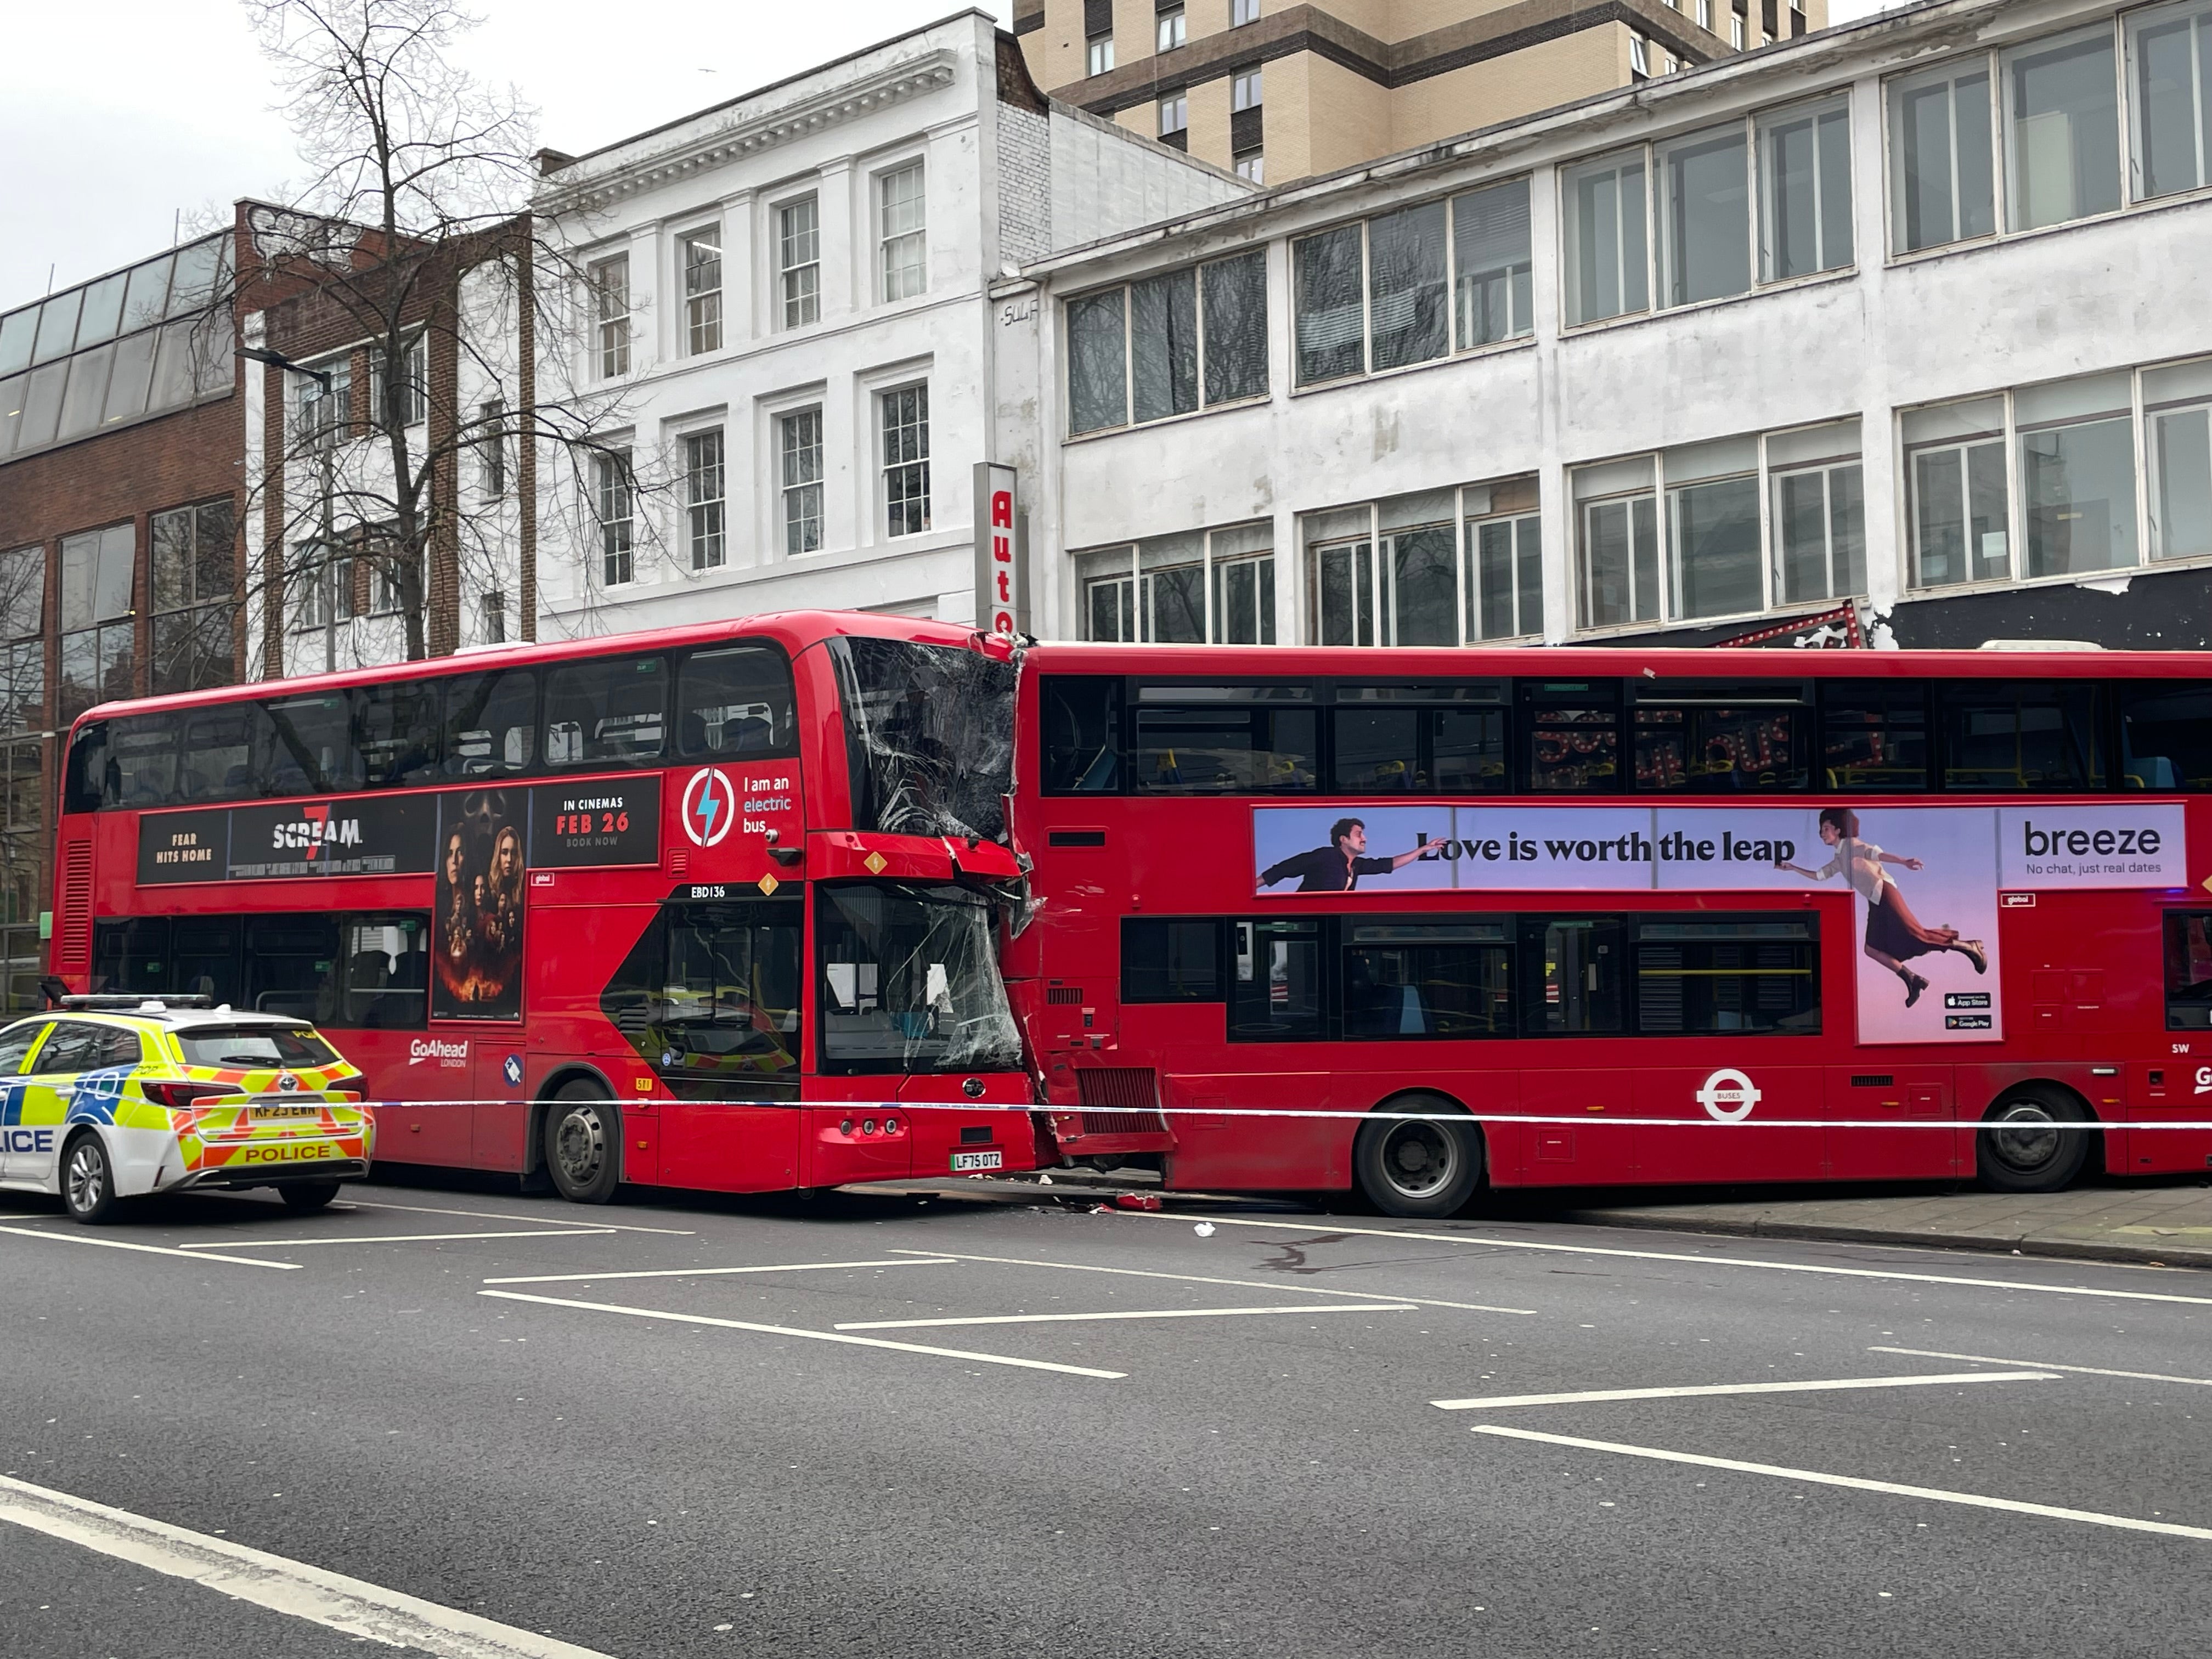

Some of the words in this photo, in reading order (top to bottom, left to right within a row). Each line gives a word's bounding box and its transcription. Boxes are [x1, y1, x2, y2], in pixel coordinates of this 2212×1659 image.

[744, 777, 747, 792] I
[751, 780, 770, 791] am
[774, 778, 788, 790] an
[564, 800, 574, 811] IN
[578, 797, 623, 810] CINEMAS
[744, 795, 791, 812] electric
[556, 815, 591, 834] FEB
[602, 812, 629, 832] 26
[743, 817, 765, 833] bus
[172, 833, 197, 847] FEAR
[566, 838, 591, 848] BOOK
[595, 836, 618, 845] NOW
[2025, 821, 2160, 855] breeze
[156, 850, 178, 863] HITS
[182, 848, 211, 862] HOME
[1417, 831, 1500, 862] Love
[1509, 831, 1537, 861] is
[1545, 831, 1652, 861] worth
[1658, 831, 1716, 861] the
[1723, 830, 1795, 867] leap
[2027, 864, 2042, 873] No
[2046, 862, 2076, 876] chat,
[2079, 862, 2101, 876] just
[2104, 862, 2125, 873] real
[2129, 861, 2162, 873] dates
[691, 887, 725, 898] EBD136
[2008, 896, 2028, 905] global
[410, 1039, 467, 1058] GoAhead
[2172, 1043, 2189, 1053] SW
[2196, 1067, 2212, 1085] G
[246, 1146, 330, 1163] POLICE
[956, 1155, 980, 1168] LF75
[983, 1154, 1000, 1166] OTZ
